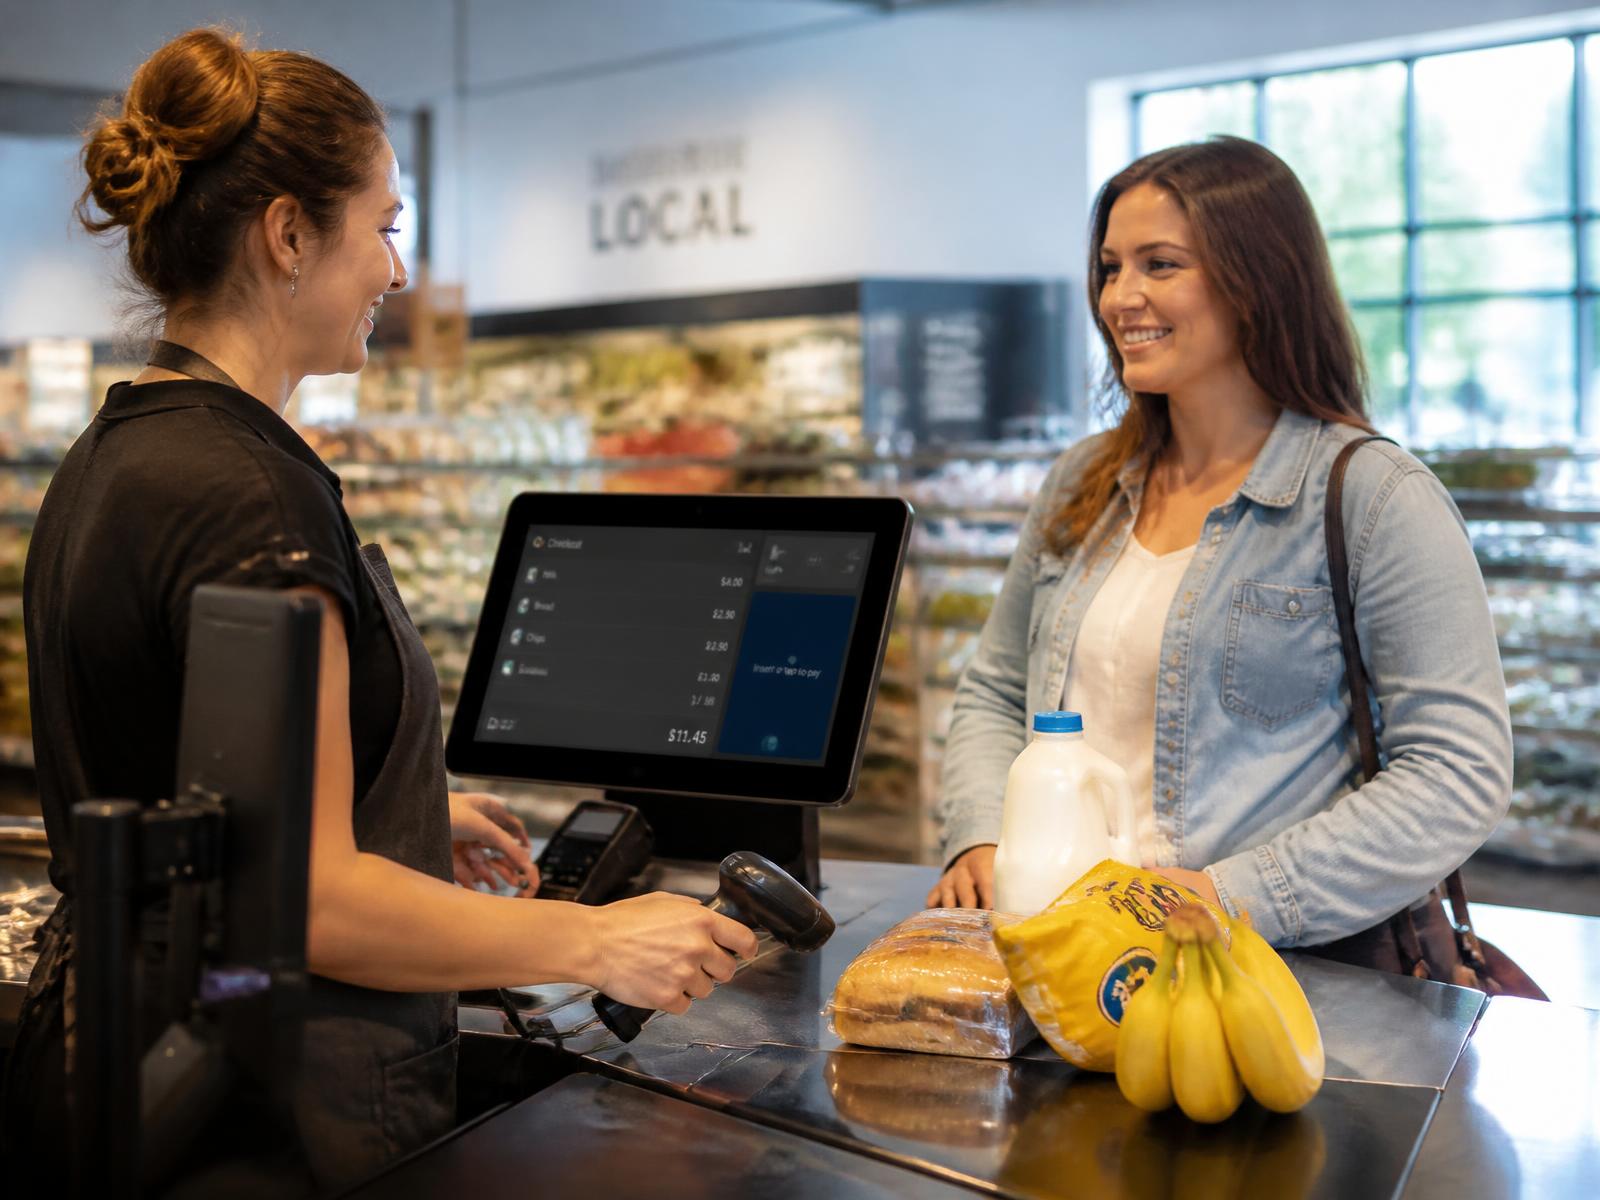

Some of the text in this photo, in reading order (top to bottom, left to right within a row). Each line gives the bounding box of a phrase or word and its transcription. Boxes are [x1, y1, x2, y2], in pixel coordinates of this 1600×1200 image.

[590, 185, 752, 252] LOCAL
[807, 669, 823, 680] pay
[667, 728, 708, 744] $11.45
